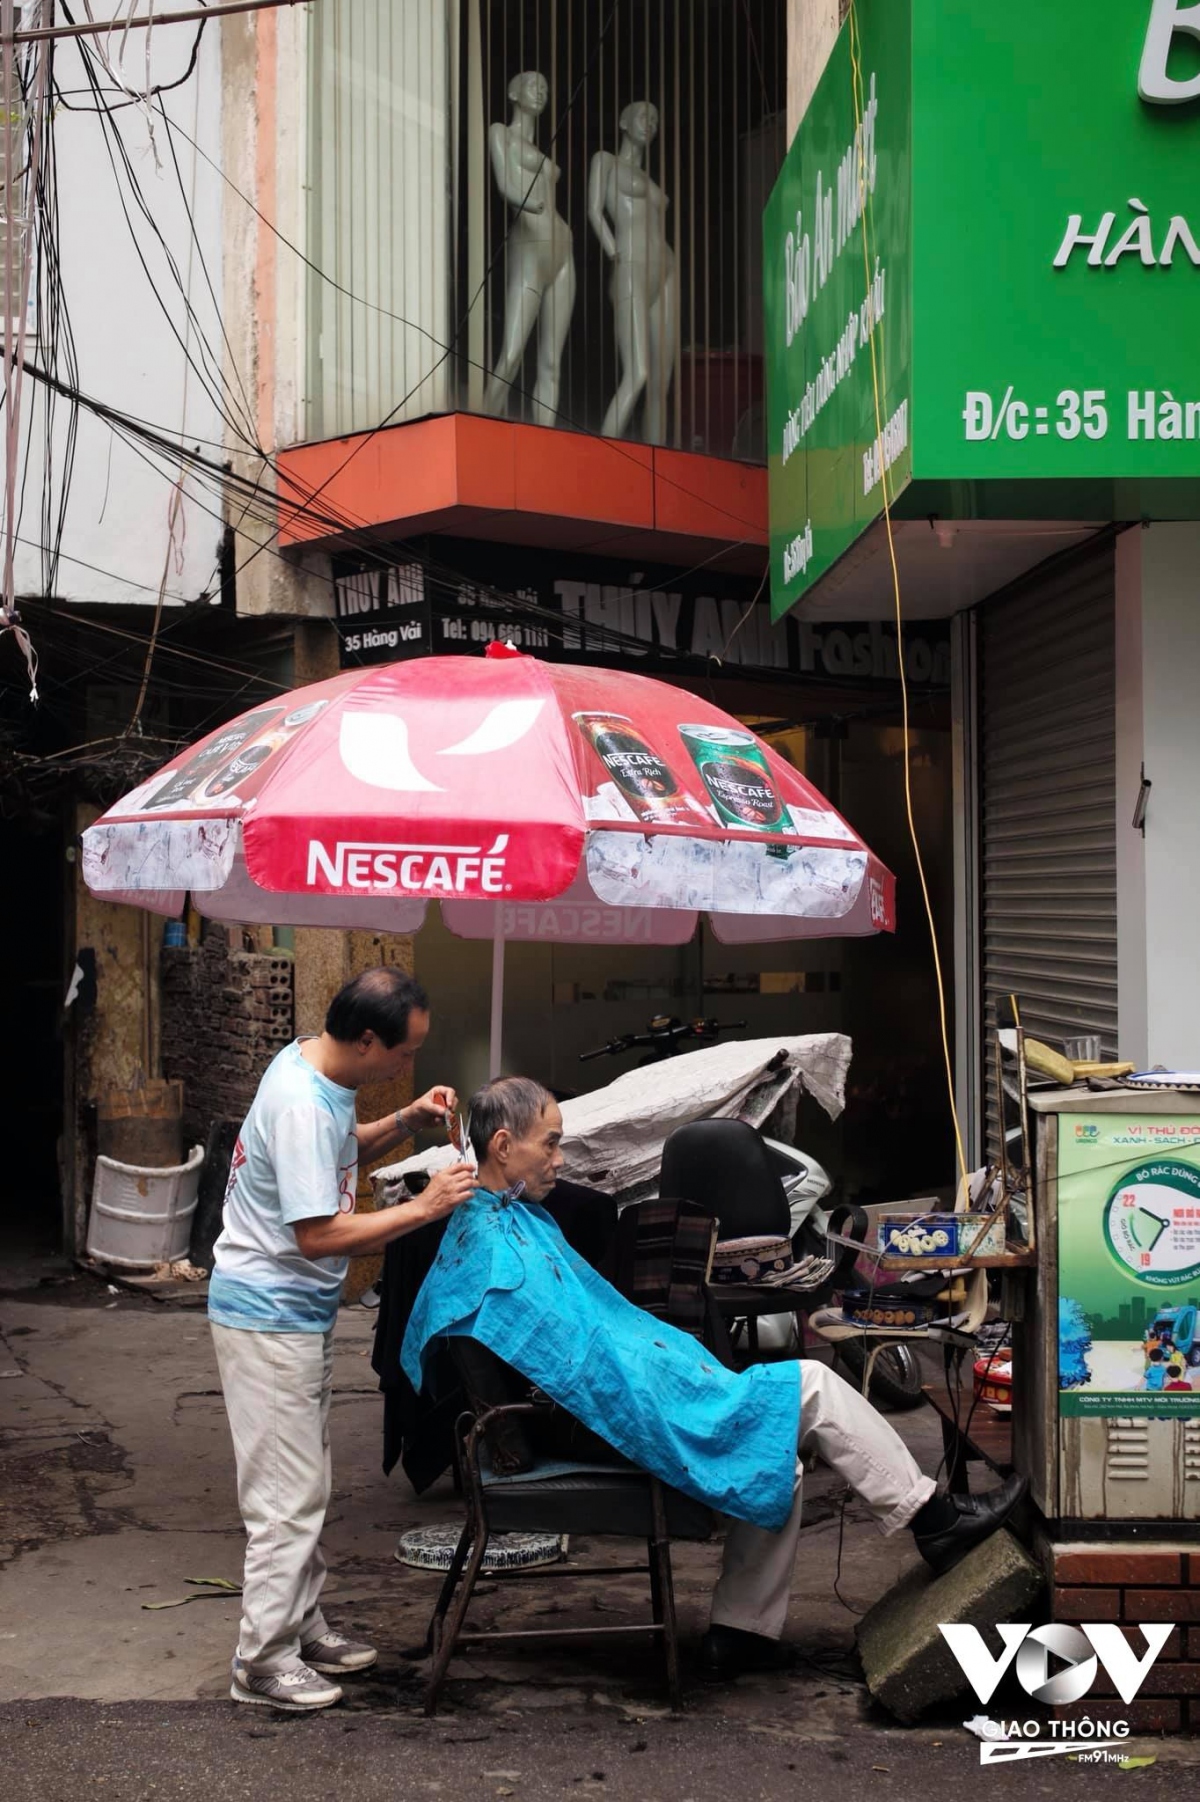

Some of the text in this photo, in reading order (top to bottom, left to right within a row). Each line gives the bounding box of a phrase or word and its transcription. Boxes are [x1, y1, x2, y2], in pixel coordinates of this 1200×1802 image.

[813, 169, 833, 301] An
[345, 620, 422, 651] 35 Hàng Vải
[442, 618, 467, 640] Tel:
[306, 834, 509, 892] NESCAFÉ
[1123, 1194, 1136, 1208] 22
[1141, 1252, 1151, 1266] 19
